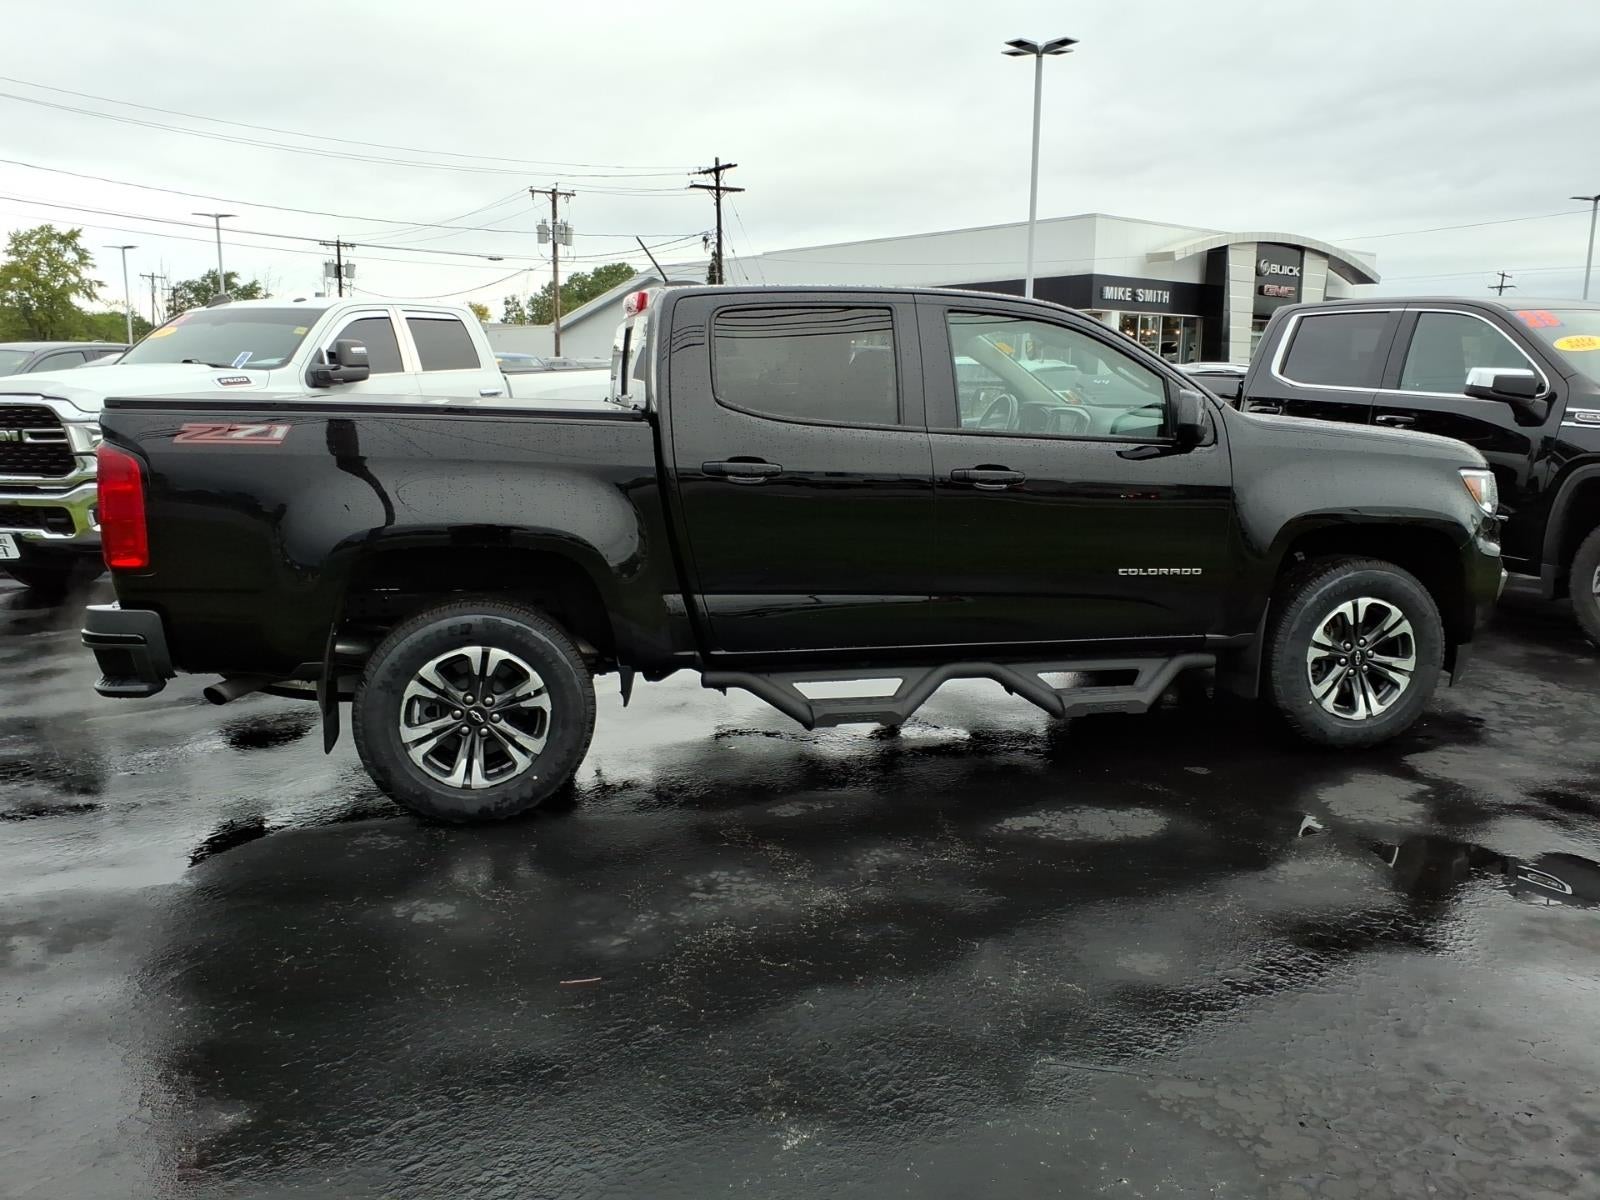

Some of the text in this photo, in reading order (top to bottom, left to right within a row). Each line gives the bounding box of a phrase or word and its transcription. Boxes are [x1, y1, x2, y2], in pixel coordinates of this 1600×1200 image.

[1270, 264, 1300, 277] BUICK
[1103, 286, 1170, 304] MIKE SMITH
[1263, 284, 1296, 298] GMC
[173, 423, 292, 444] Z71
[1118, 568, 1202, 576] COLORADO
